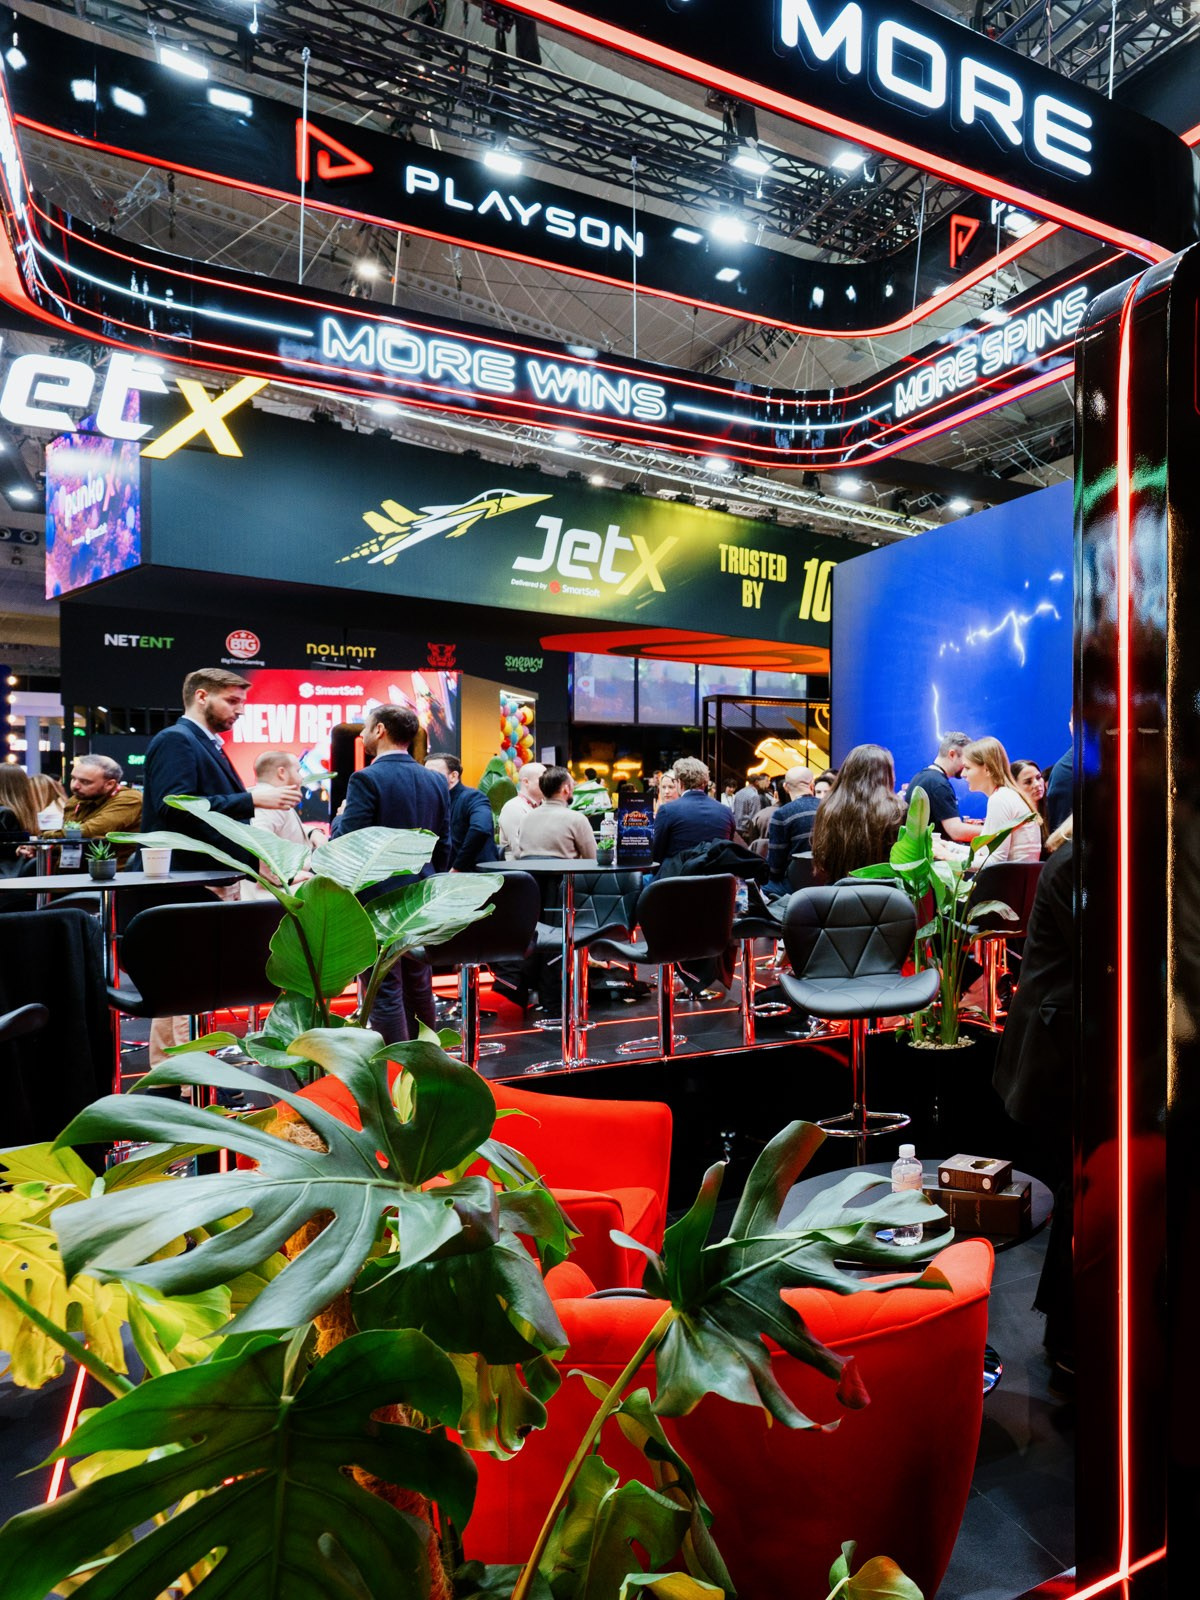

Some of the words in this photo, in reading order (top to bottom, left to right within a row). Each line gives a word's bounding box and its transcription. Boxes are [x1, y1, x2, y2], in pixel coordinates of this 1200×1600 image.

[780, 0, 1093, 177] MORE
[405, 164, 644, 258] PLAYSON
[323, 317, 516, 393] MORE
[528, 360, 667, 421] WINS
[894, 343, 979, 418] MORE
[981, 286, 1088, 375] SPINS
[0, 353, 270, 460] etX
[510, 578, 539, 588] Delivered
[718, 543, 788, 583] TRUSTED
[742, 579, 764, 609] BY
[229, 638, 257, 651] BTG
[315, 685, 364, 697] SmartSoft
[233, 704, 297, 743] NEW
